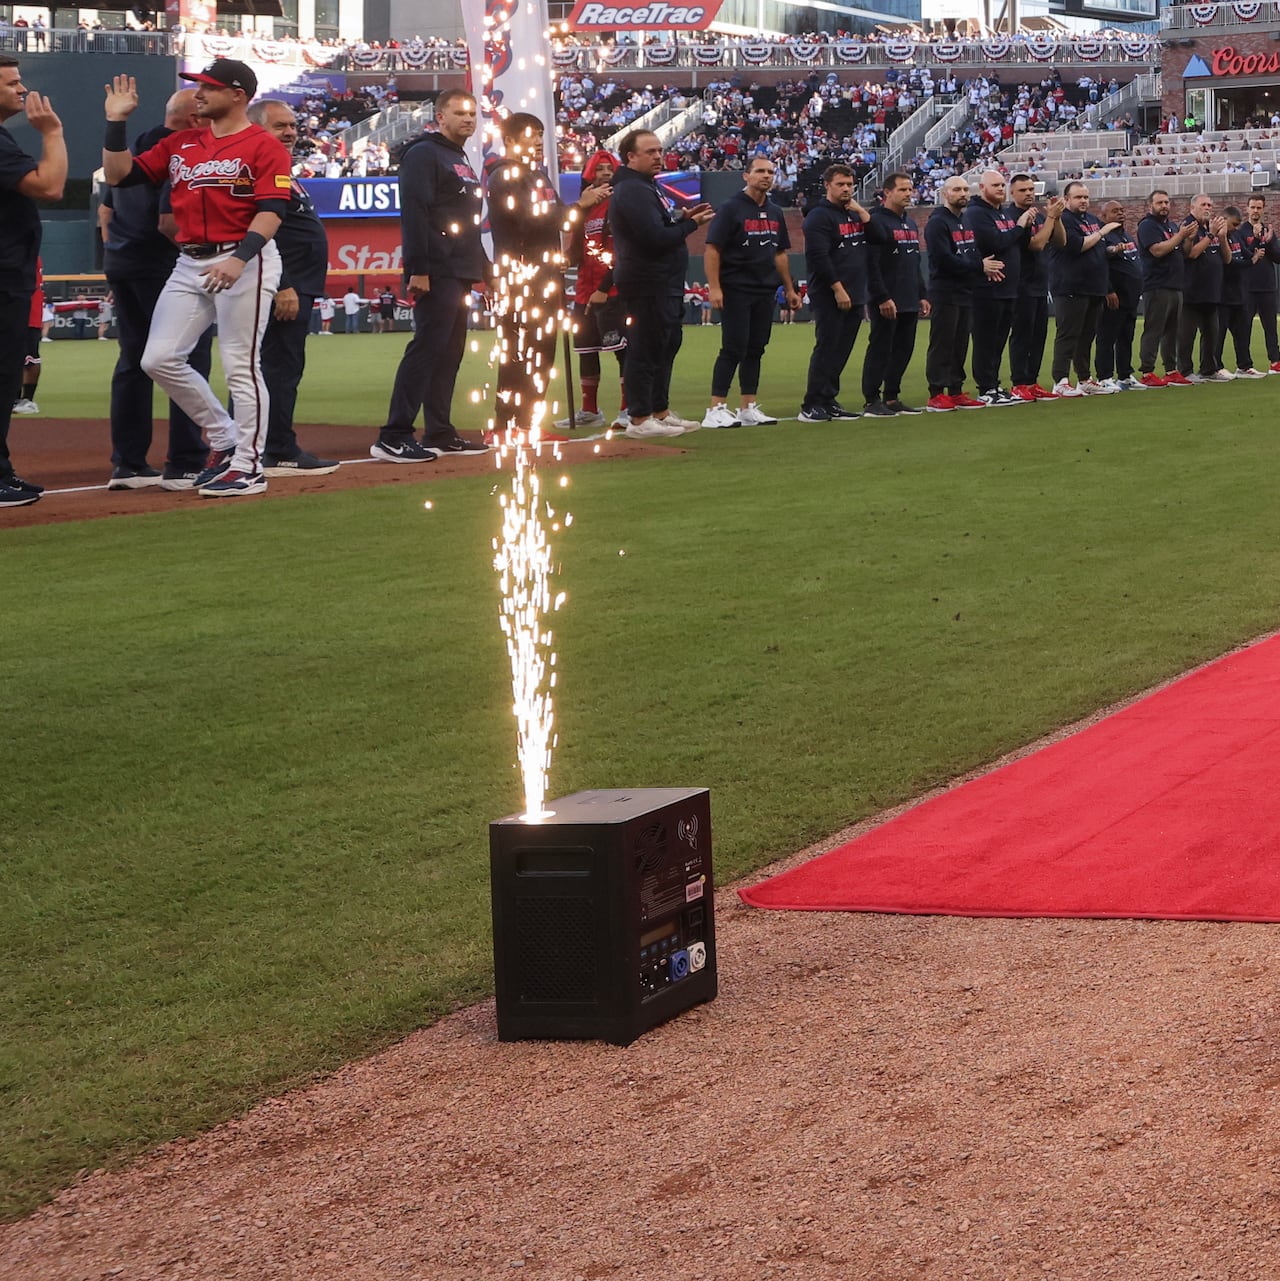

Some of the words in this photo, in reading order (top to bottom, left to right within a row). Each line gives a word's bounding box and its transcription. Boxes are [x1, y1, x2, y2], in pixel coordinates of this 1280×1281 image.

[576, 3, 704, 25] RaceTrac
[1211, 46, 1280, 76] Coors
[339, 183, 400, 210] AUST
[337, 244, 402, 271] Stat
